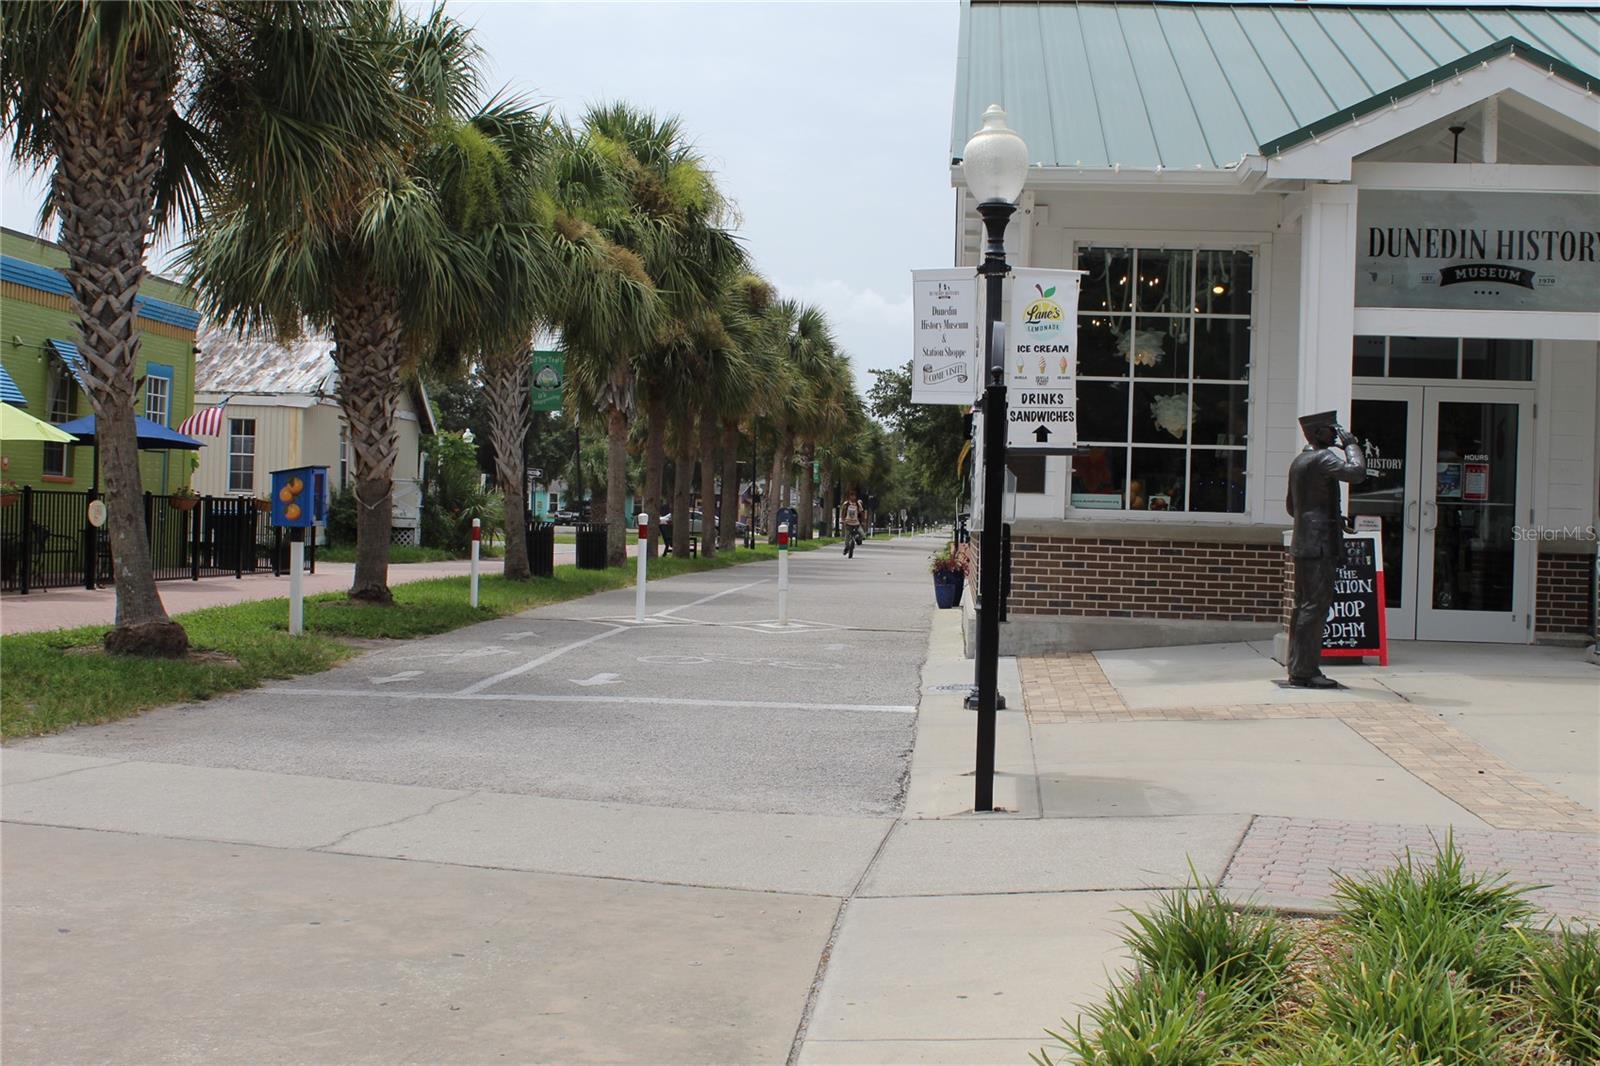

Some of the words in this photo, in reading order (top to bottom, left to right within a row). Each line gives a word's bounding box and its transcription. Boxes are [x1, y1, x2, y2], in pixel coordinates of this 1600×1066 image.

[1369, 227, 1488, 260] DUNEDIN
[1496, 229, 1600, 262] HISTOR
[1454, 267, 1521, 281] MUSEUM
[932, 306, 957, 316] Dunedin
[1025, 304, 1061, 325] Lane's
[921, 320, 942, 331] History
[944, 319, 969, 330] Museum
[1027, 324, 1060, 332] LEMONADE
[922, 346, 944, 357] Station
[945, 347, 967, 359] Shoppe
[1017, 344, 1032, 353] ICE
[1033, 344, 1069, 353] CREAM
[928, 371, 944, 382] COME
[1021, 393, 1064, 405] DRINKS
[1010, 410, 1075, 422] SANDWICHES
[1367, 458, 1402, 469] HISTORY
